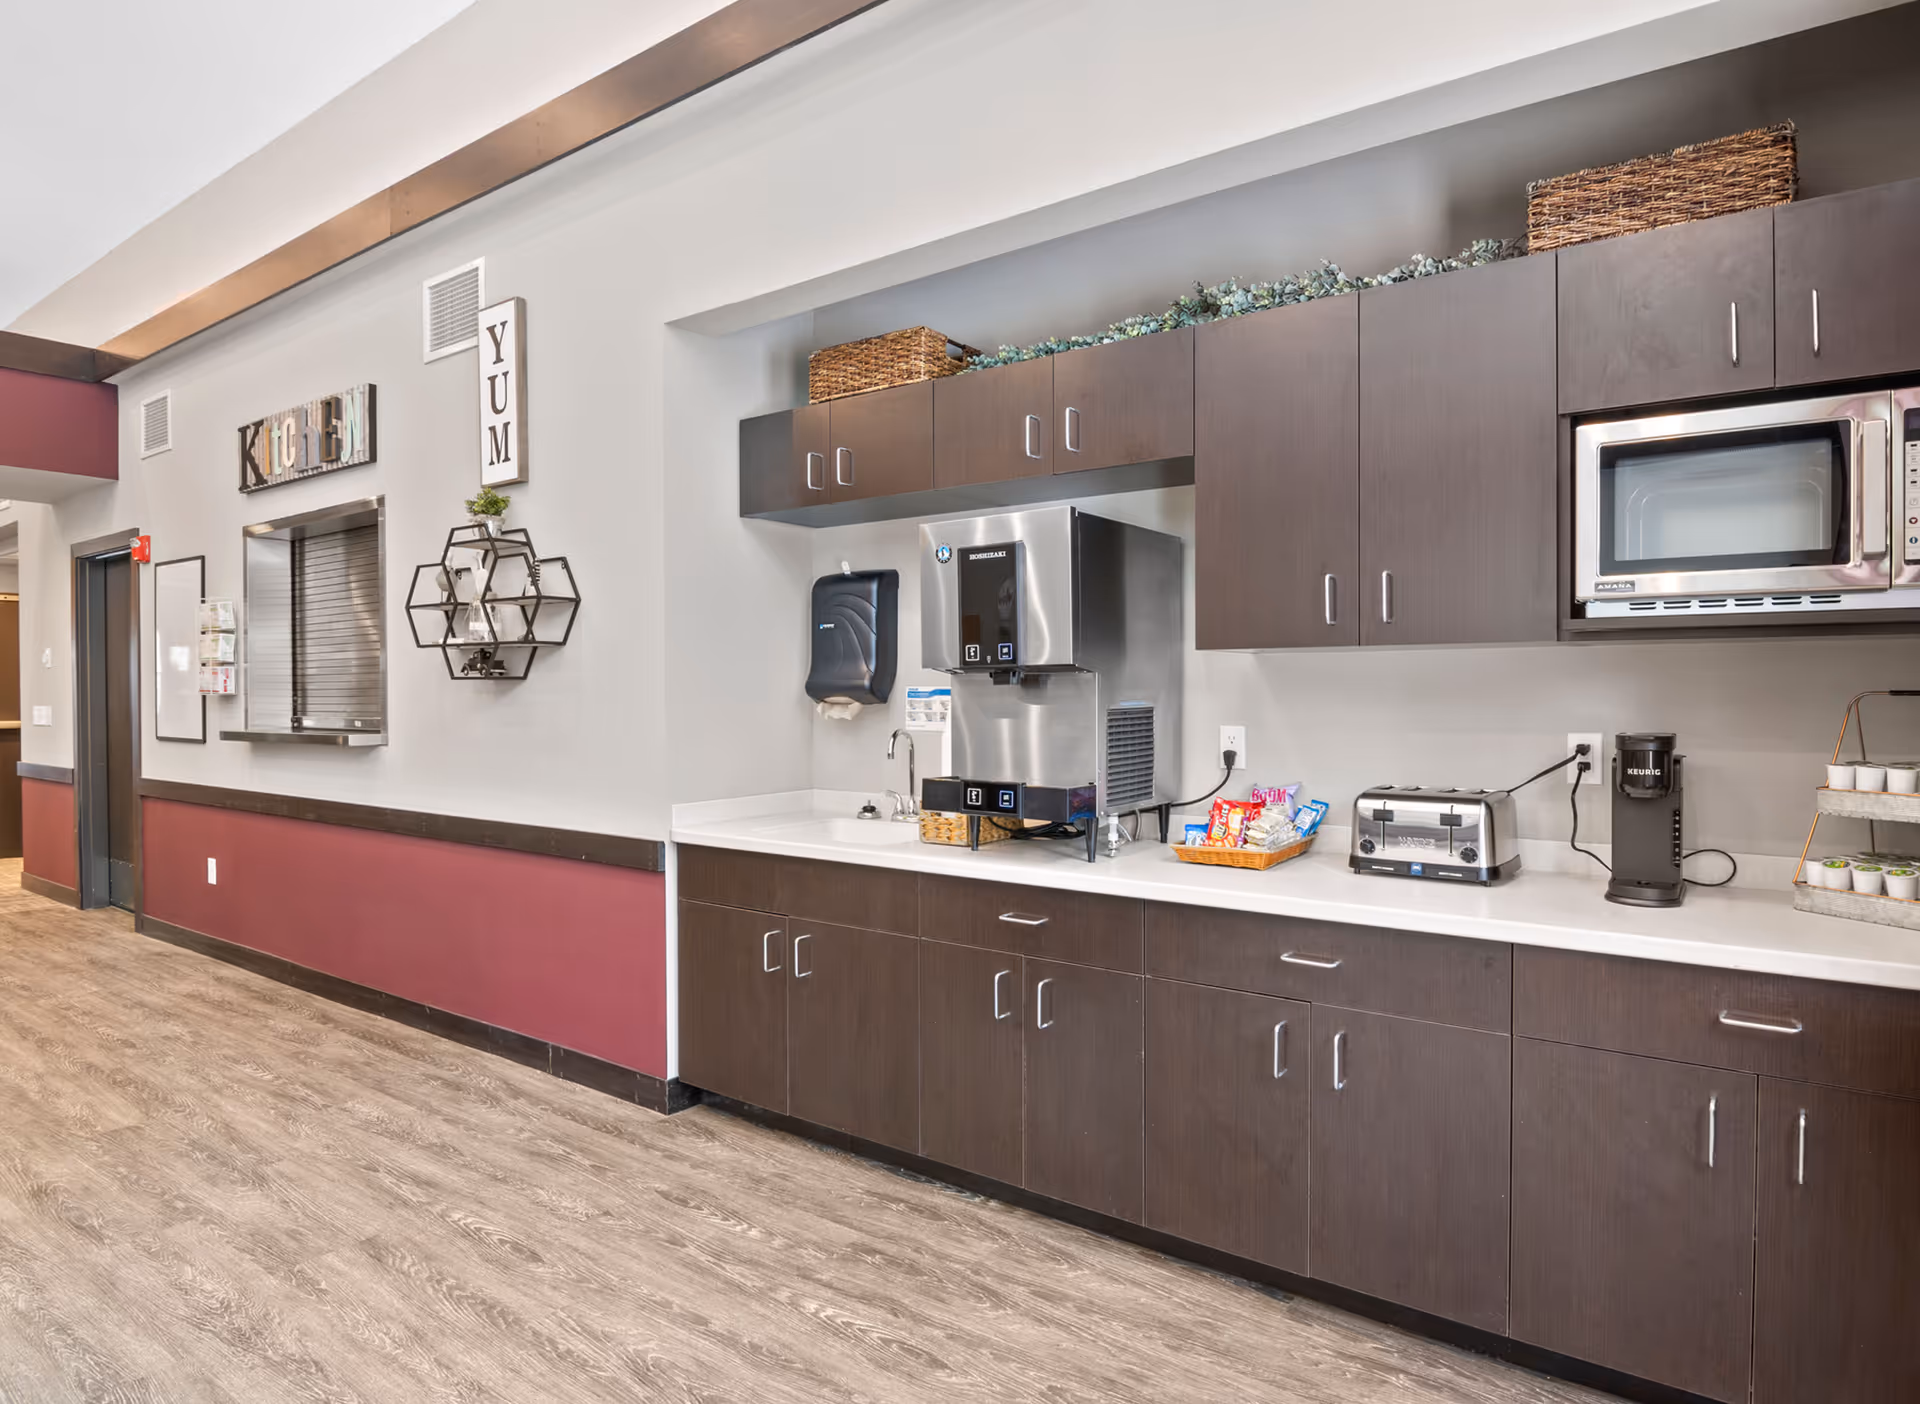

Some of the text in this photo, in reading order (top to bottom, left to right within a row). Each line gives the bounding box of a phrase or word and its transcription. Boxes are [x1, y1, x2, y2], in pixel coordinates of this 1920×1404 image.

[486, 320, 511, 466] YUM
[969, 550, 1006, 560] HOSHIZAKI
[1251, 787, 1287, 803] BOOM
